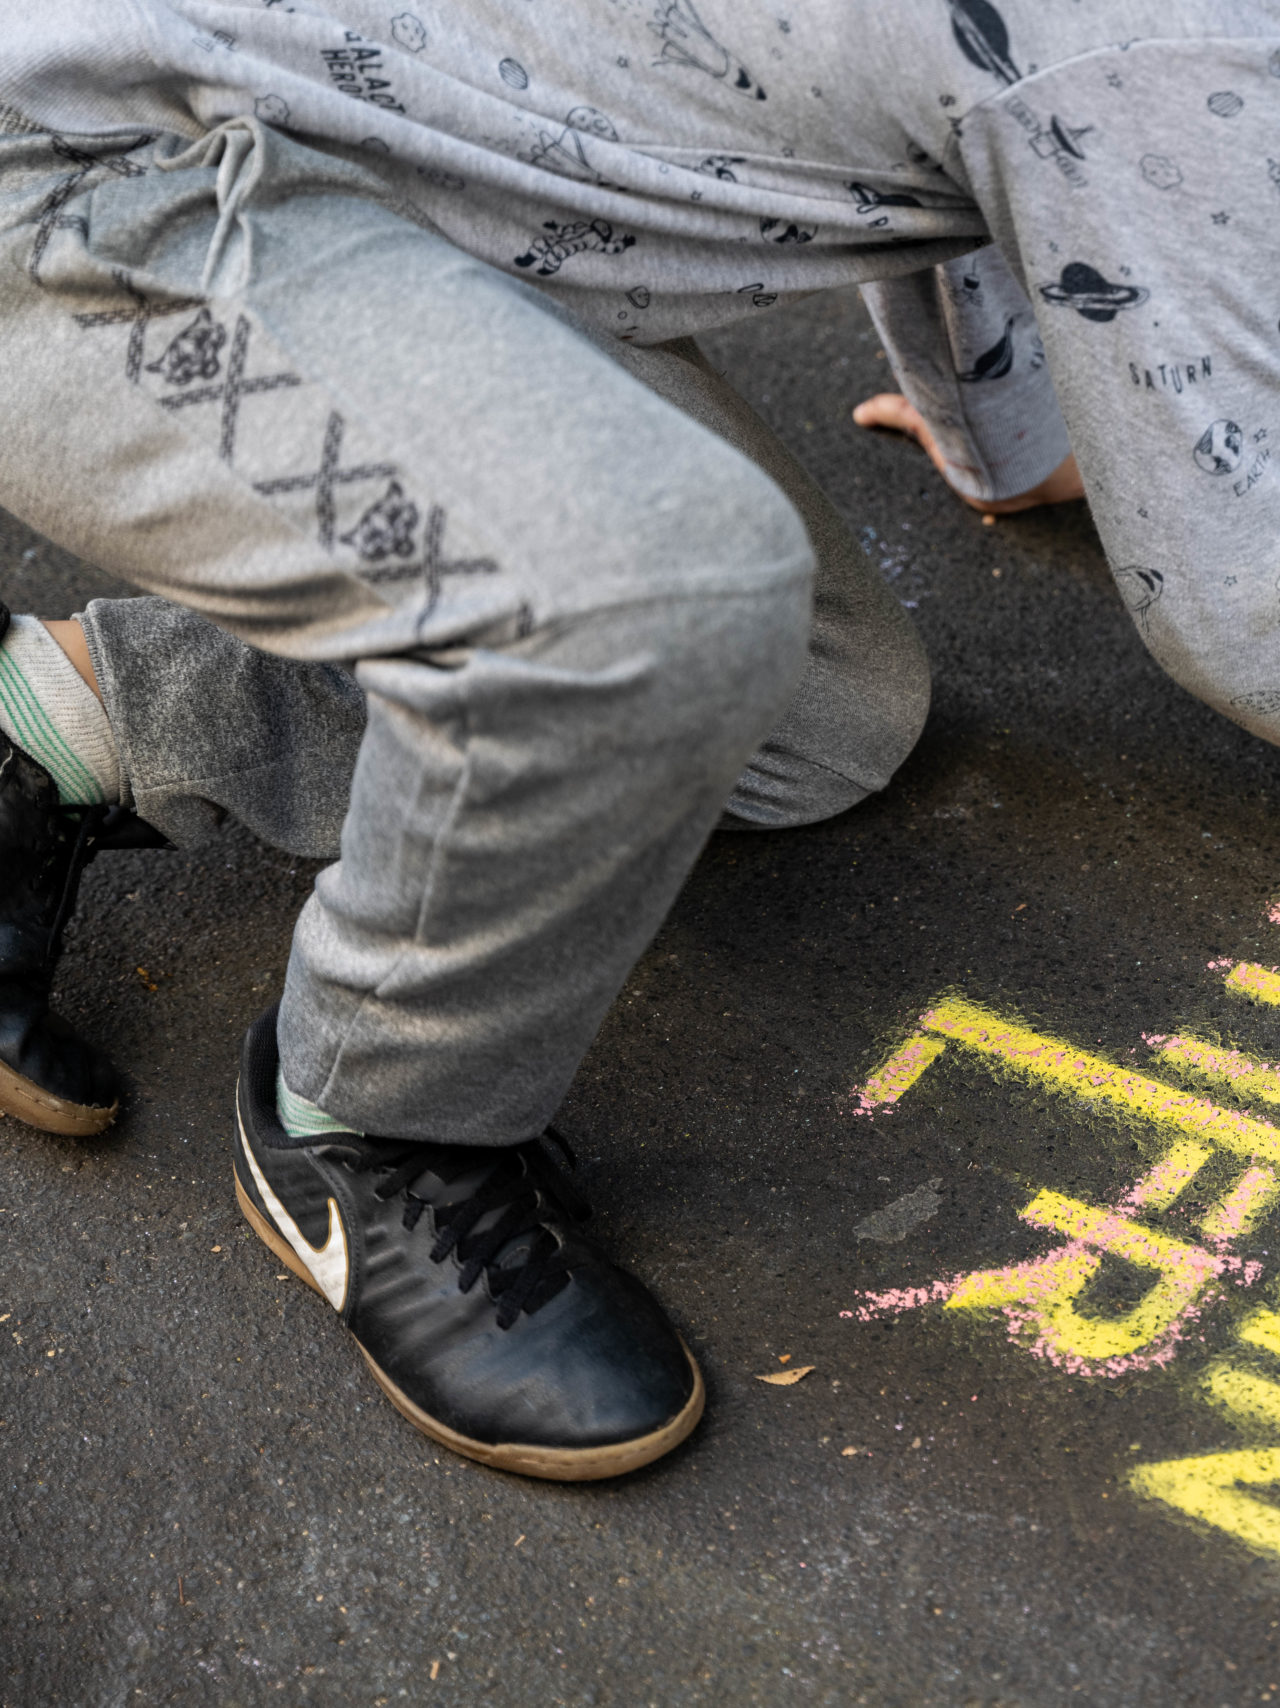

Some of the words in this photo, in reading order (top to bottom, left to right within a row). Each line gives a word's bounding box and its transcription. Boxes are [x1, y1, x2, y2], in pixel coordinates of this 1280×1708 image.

[320, 48, 367, 102] HERO
[1128, 355, 1211, 394] SATURN
[1232, 448, 1270, 497] EARTH
